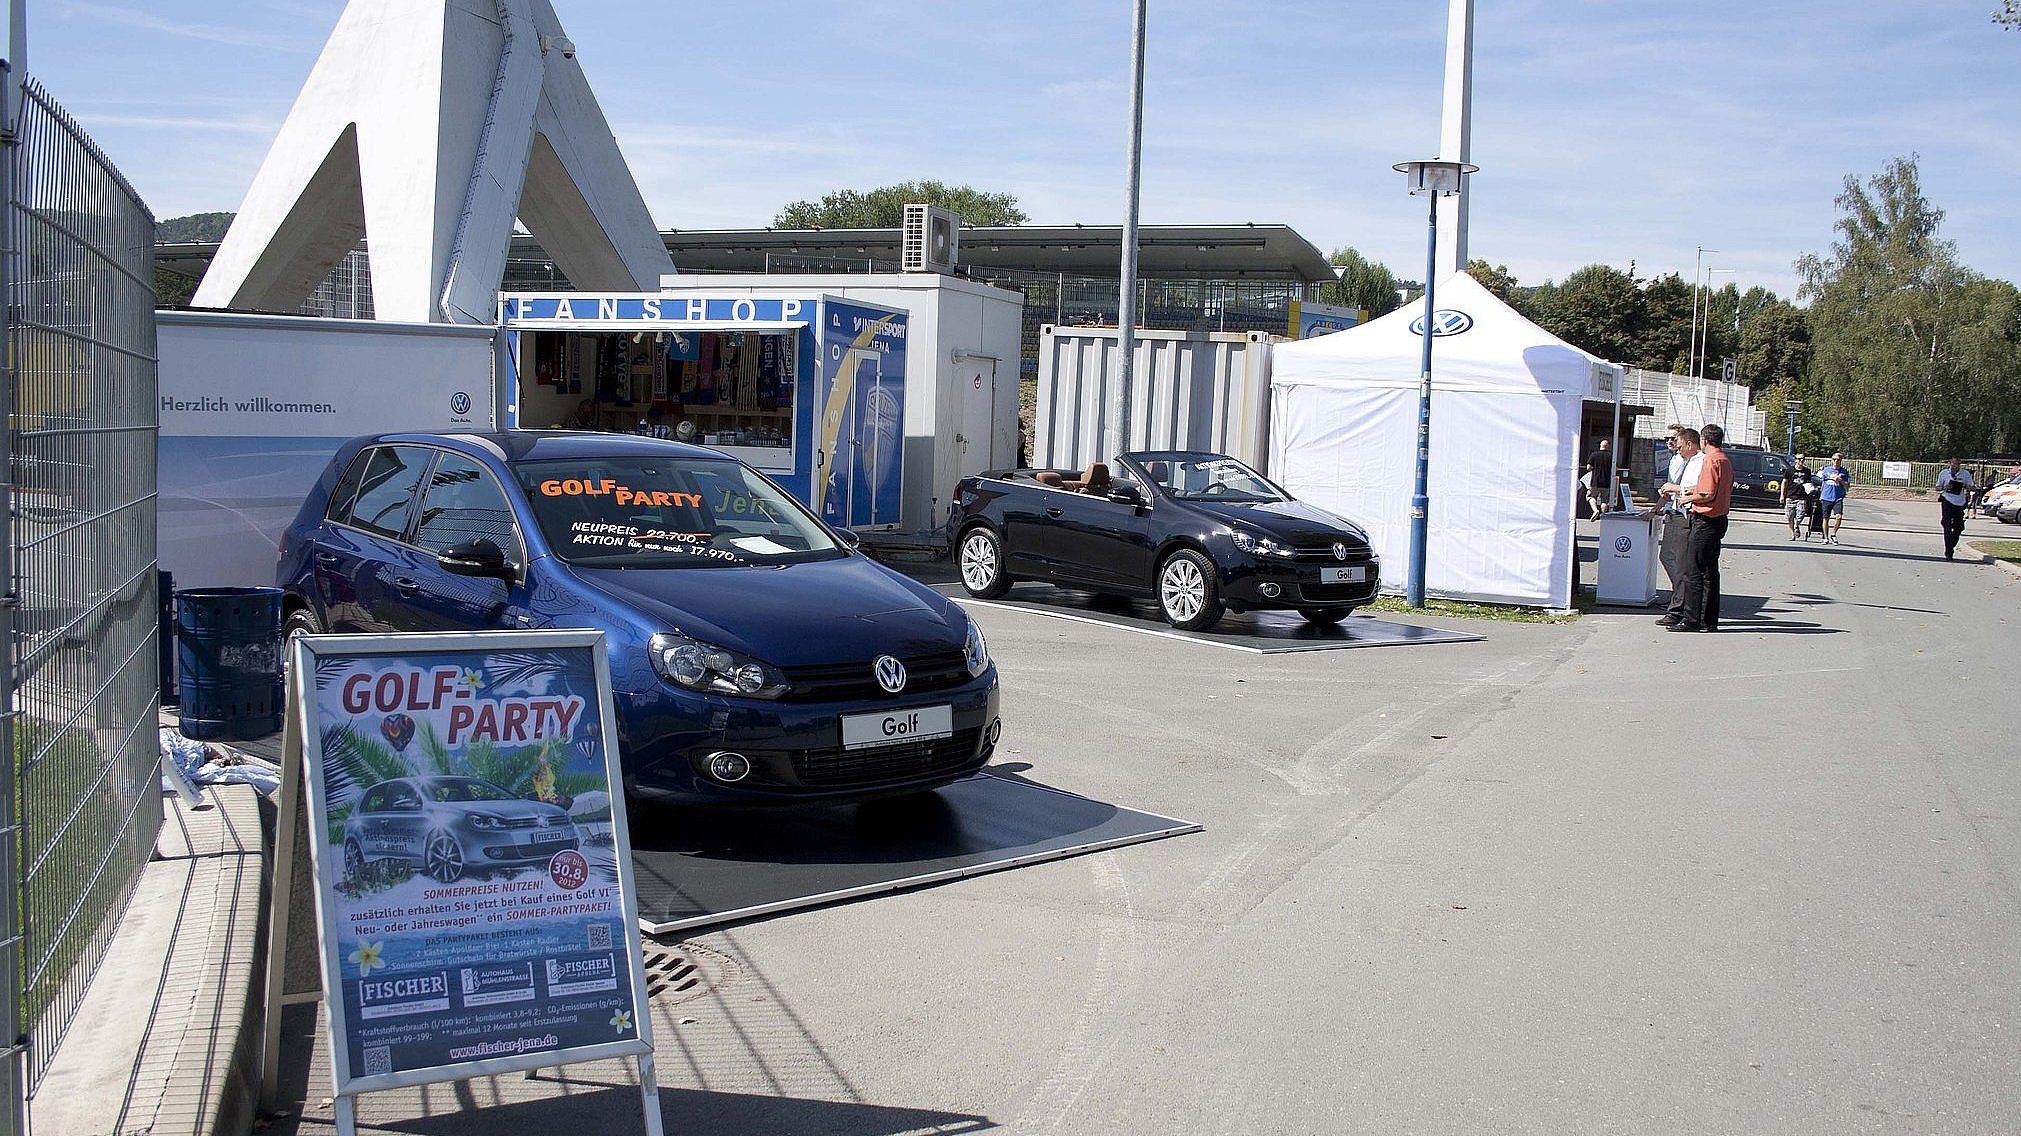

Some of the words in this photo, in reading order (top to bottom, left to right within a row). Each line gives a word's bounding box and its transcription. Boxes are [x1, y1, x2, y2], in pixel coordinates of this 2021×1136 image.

[518, 298, 802, 321] FANSHOP
[862, 318, 905, 339] INTERSPORT
[1725, 362, 1735, 382] G
[161, 396, 229, 412] Herzlich
[234, 398, 336, 414] willkommen.
[540, 478, 629, 497] GOLF-
[616, 490, 703, 508] PARTY
[571, 522, 639, 536] NEUPREIS
[573, 534, 624, 546] AKTION
[1337, 569, 1353, 580] Golf
[342, 670, 471, 714] GOLF-
[447, 700, 581, 744] PARTY
[882, 713, 919, 736] Golf
[553, 862, 585, 881] 30.8.
[424, 884, 498, 899] SOMMERPREISE
[502, 880, 544, 893] NUTZEN!
[559, 877, 576, 887] 2012
[351, 907, 404, 921] zusätzlich
[408, 904, 451, 915] erhalten
[454, 900, 470, 911] Sie
[473, 899, 500, 912] jetzt
[501, 896, 517, 907] bei
[521, 894, 543, 904] Kauf
[547, 892, 573, 902] eines
[576, 888, 595, 900] Golf
[355, 925, 380, 935] Neu-
[384, 922, 408, 932] oder
[487, 912, 503, 922] ein
[506, 902, 611, 920] SOMMER-PARTYPAKET!
[443, 933, 488, 943] PARTYPAKET
[491, 929, 522, 939] BESTEHT
[565, 959, 610, 973] FISCHER
[364, 977, 444, 1000] FISCHER
[483, 1025, 491, 1033] 12
[449, 1034, 558, 1058] www.fischer-jena.de
